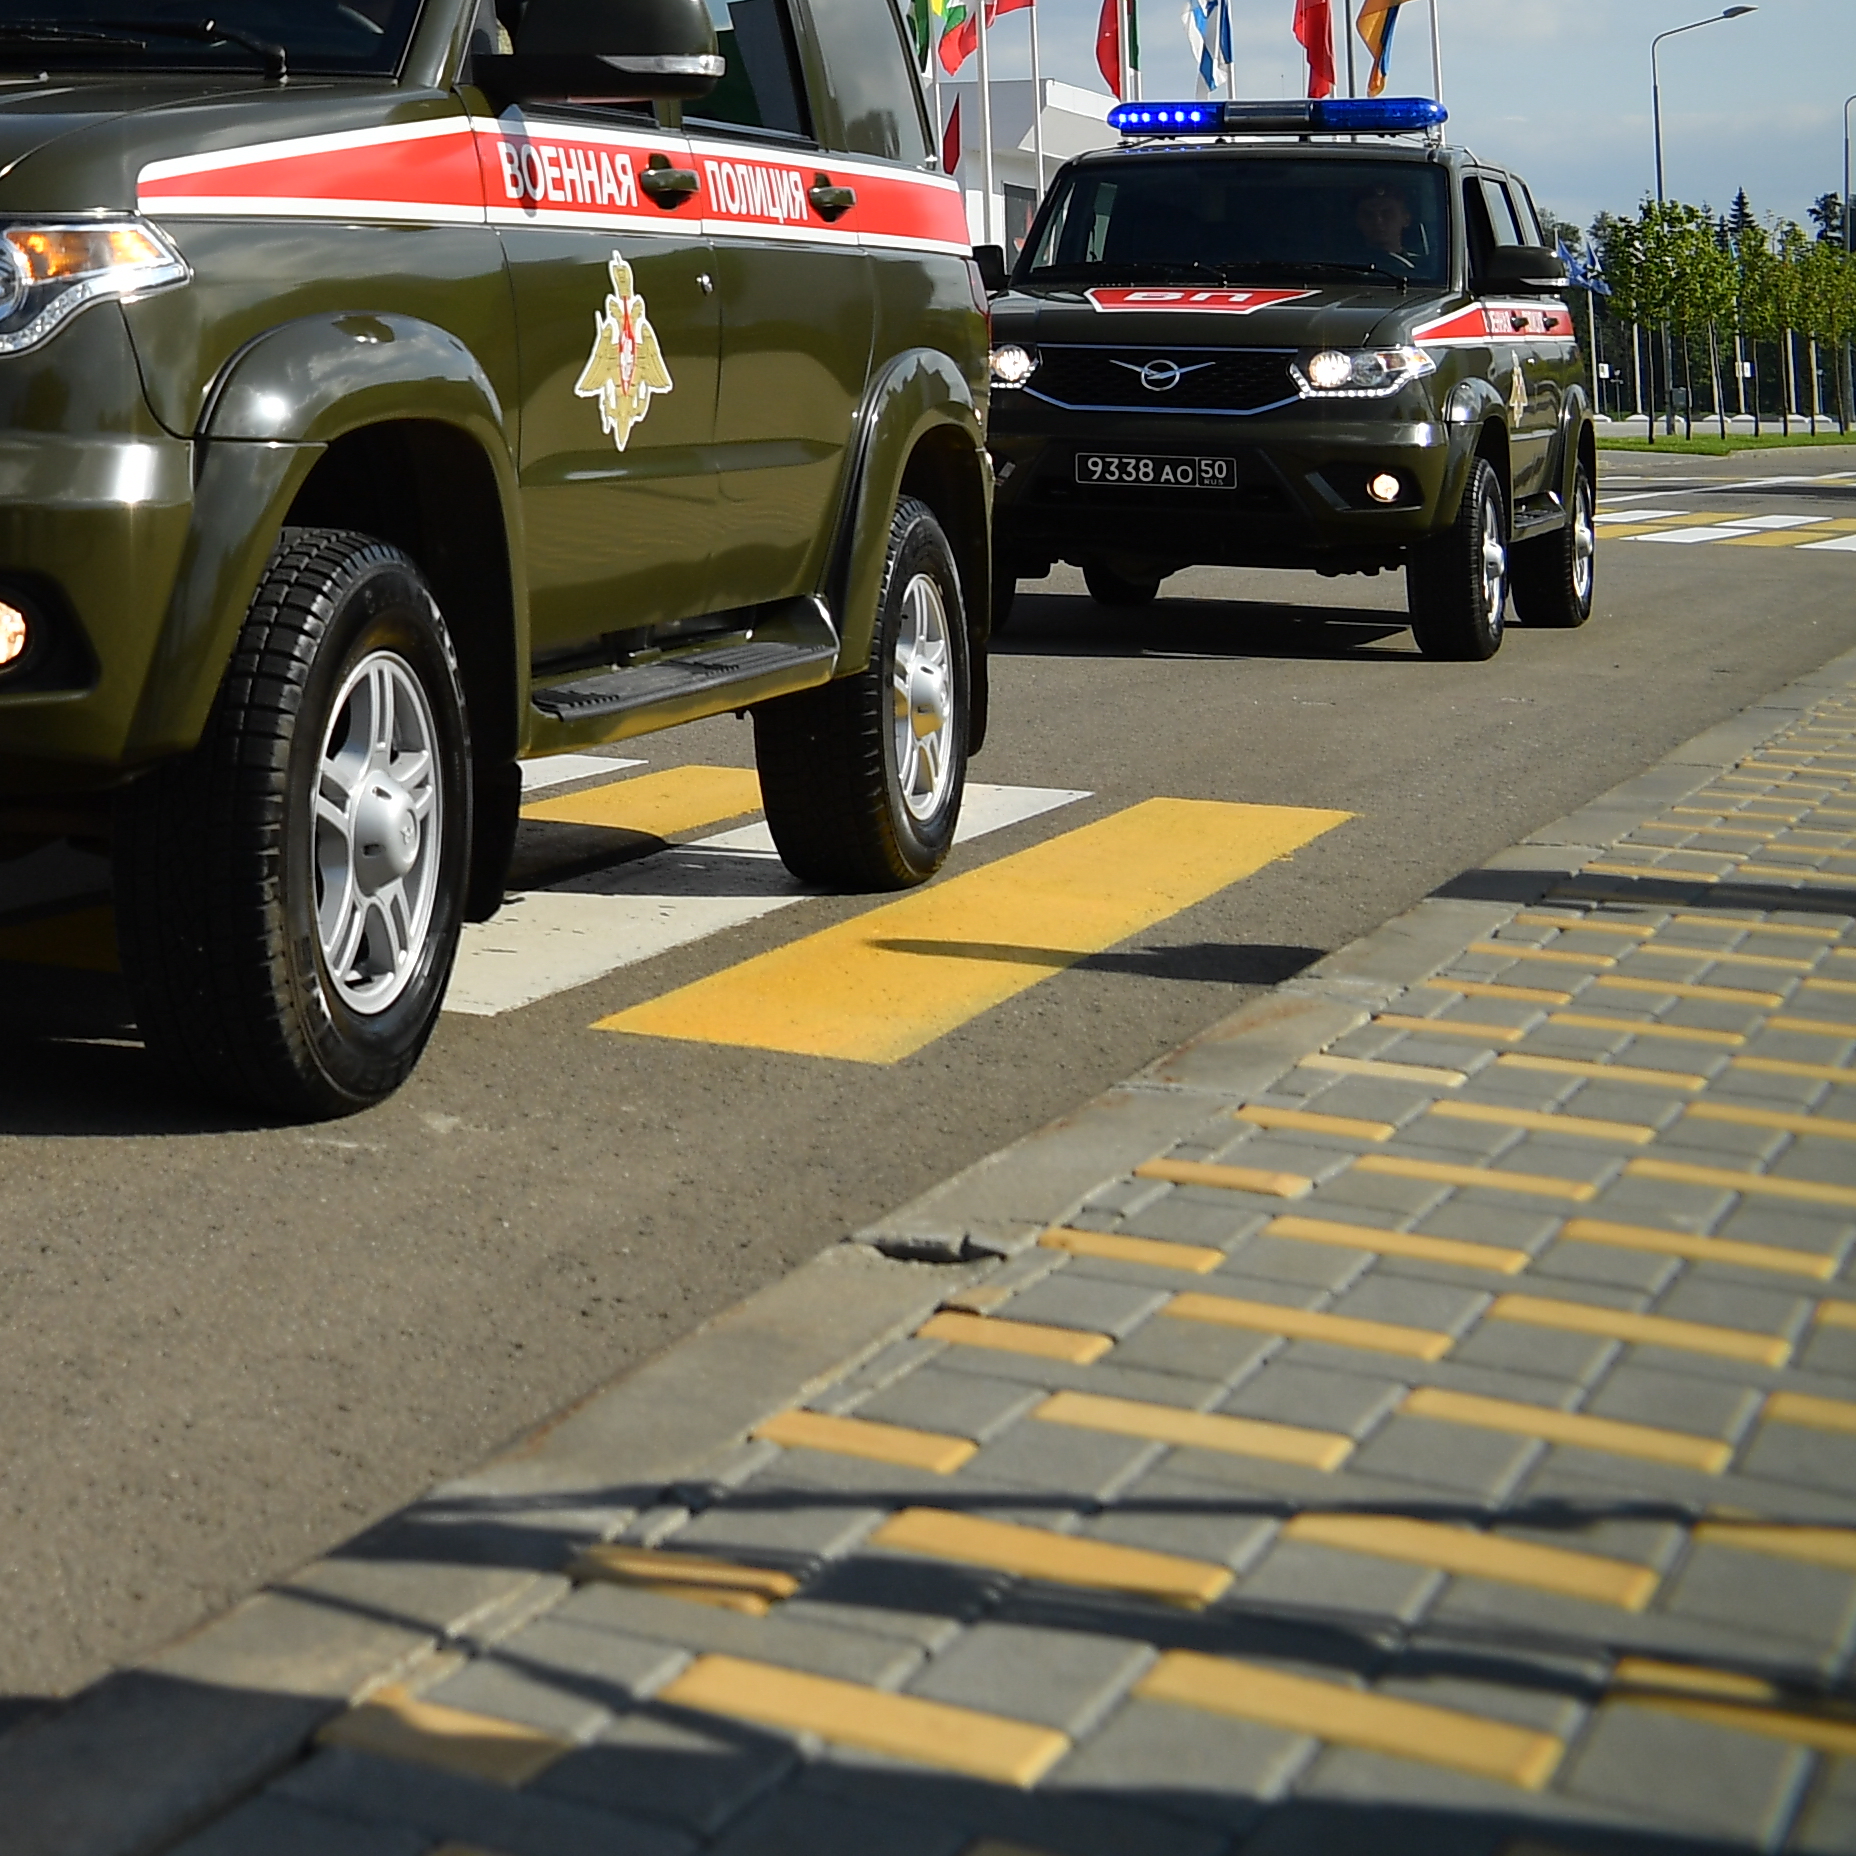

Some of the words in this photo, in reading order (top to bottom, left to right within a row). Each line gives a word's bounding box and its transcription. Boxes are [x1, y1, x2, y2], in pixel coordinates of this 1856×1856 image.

[496, 141, 639, 208] ВОЕННАЯ
[704, 160, 809, 224] ПОЛИЦИЯ
[1087, 457, 1154, 482] 9338
[1200, 460, 1227, 478] 50
